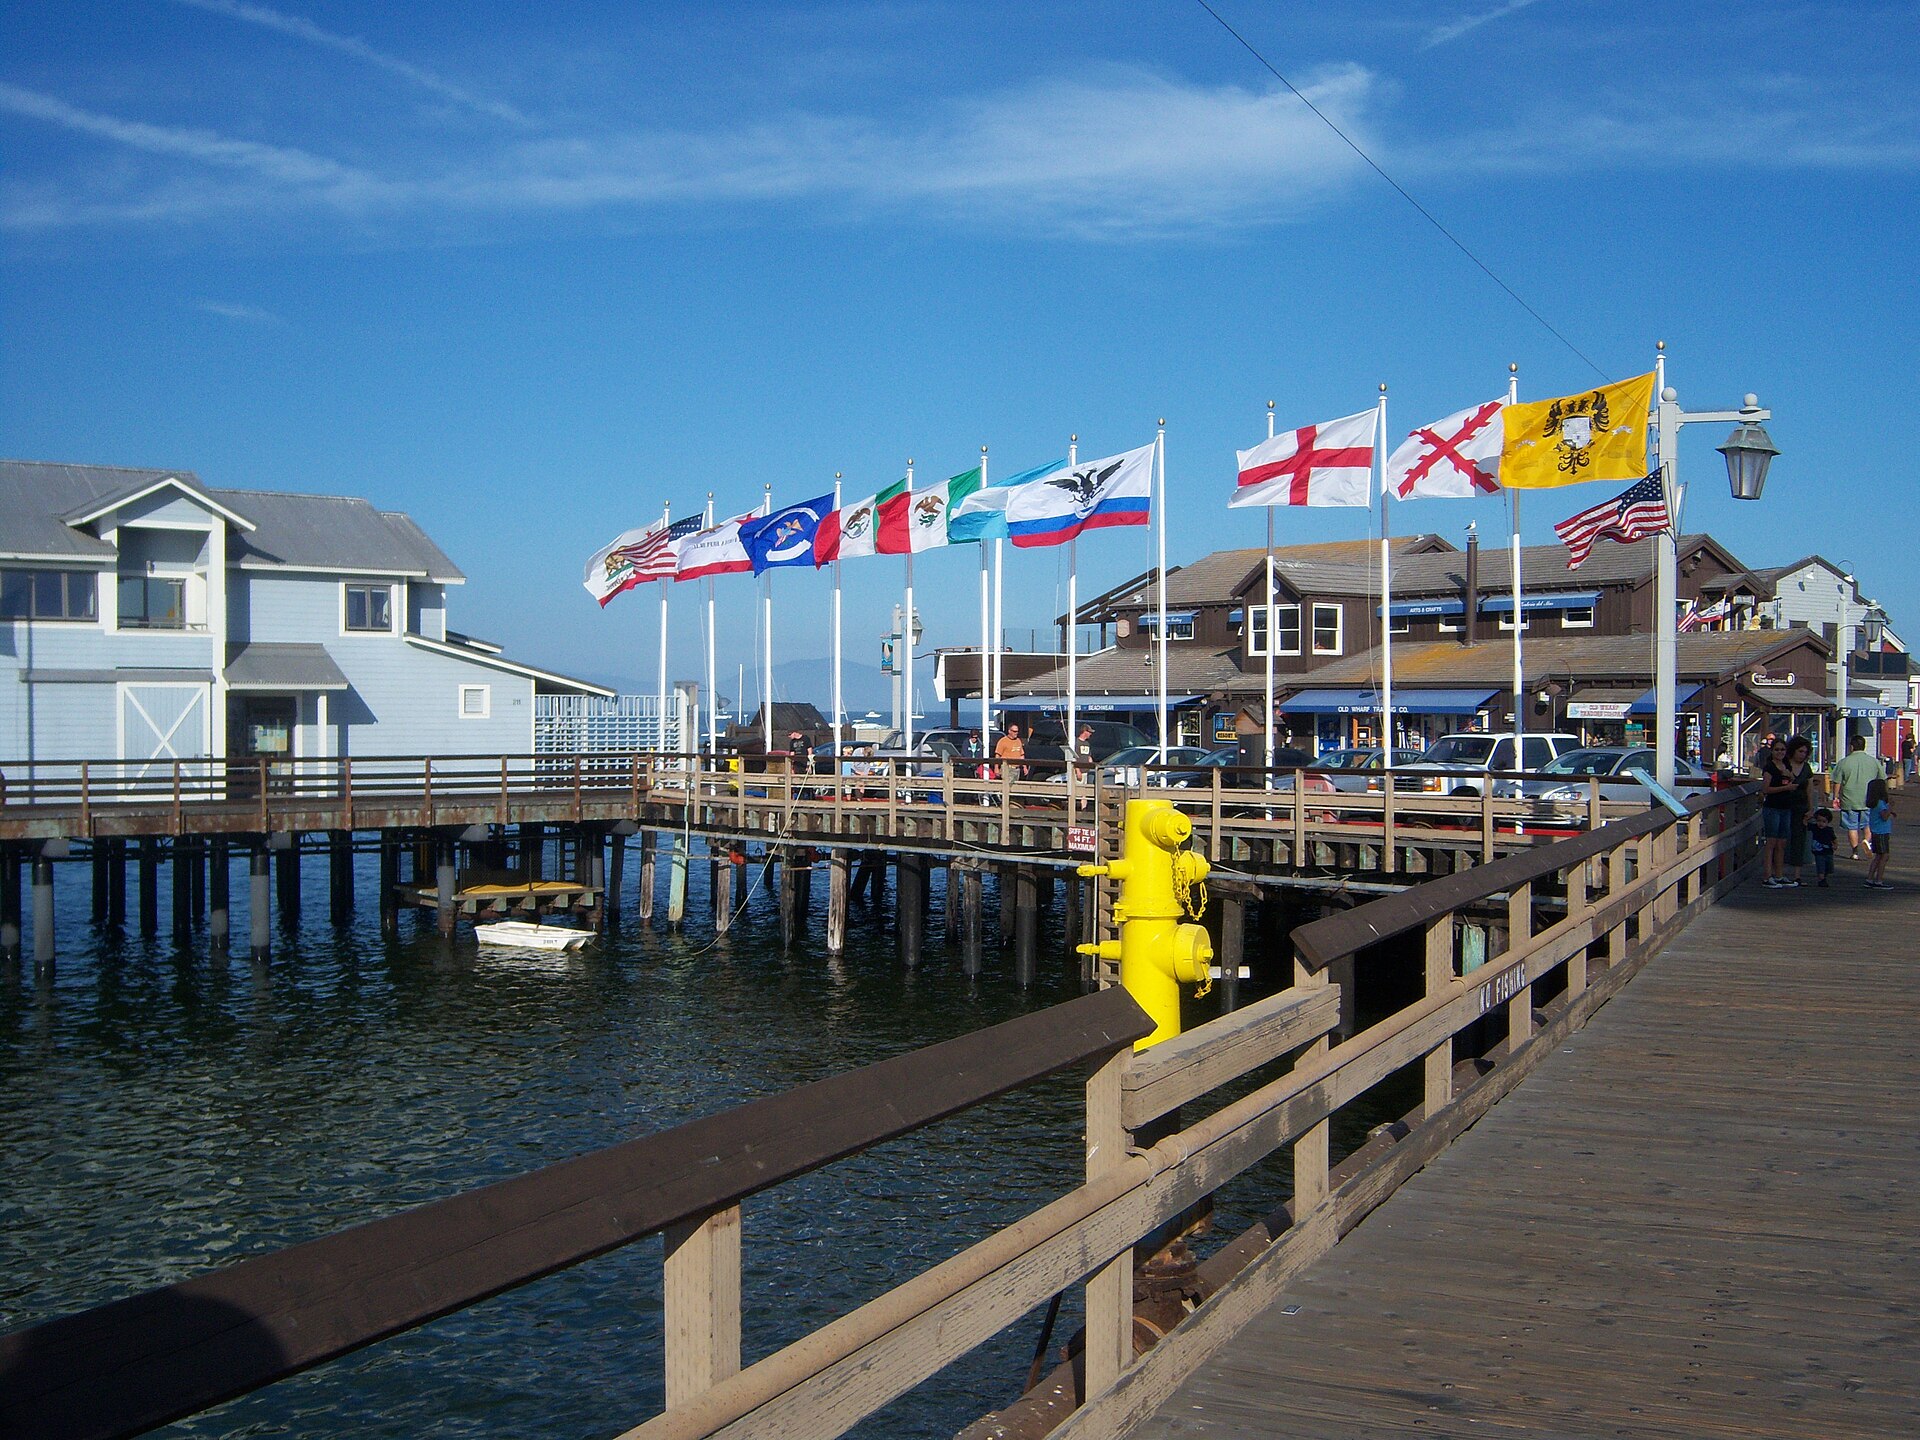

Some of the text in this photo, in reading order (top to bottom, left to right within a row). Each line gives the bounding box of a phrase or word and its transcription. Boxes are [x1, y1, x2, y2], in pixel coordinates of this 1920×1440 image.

[1857, 709, 1886, 717] ICE CREAM
[1480, 963, 1525, 1013] NO FISHING
